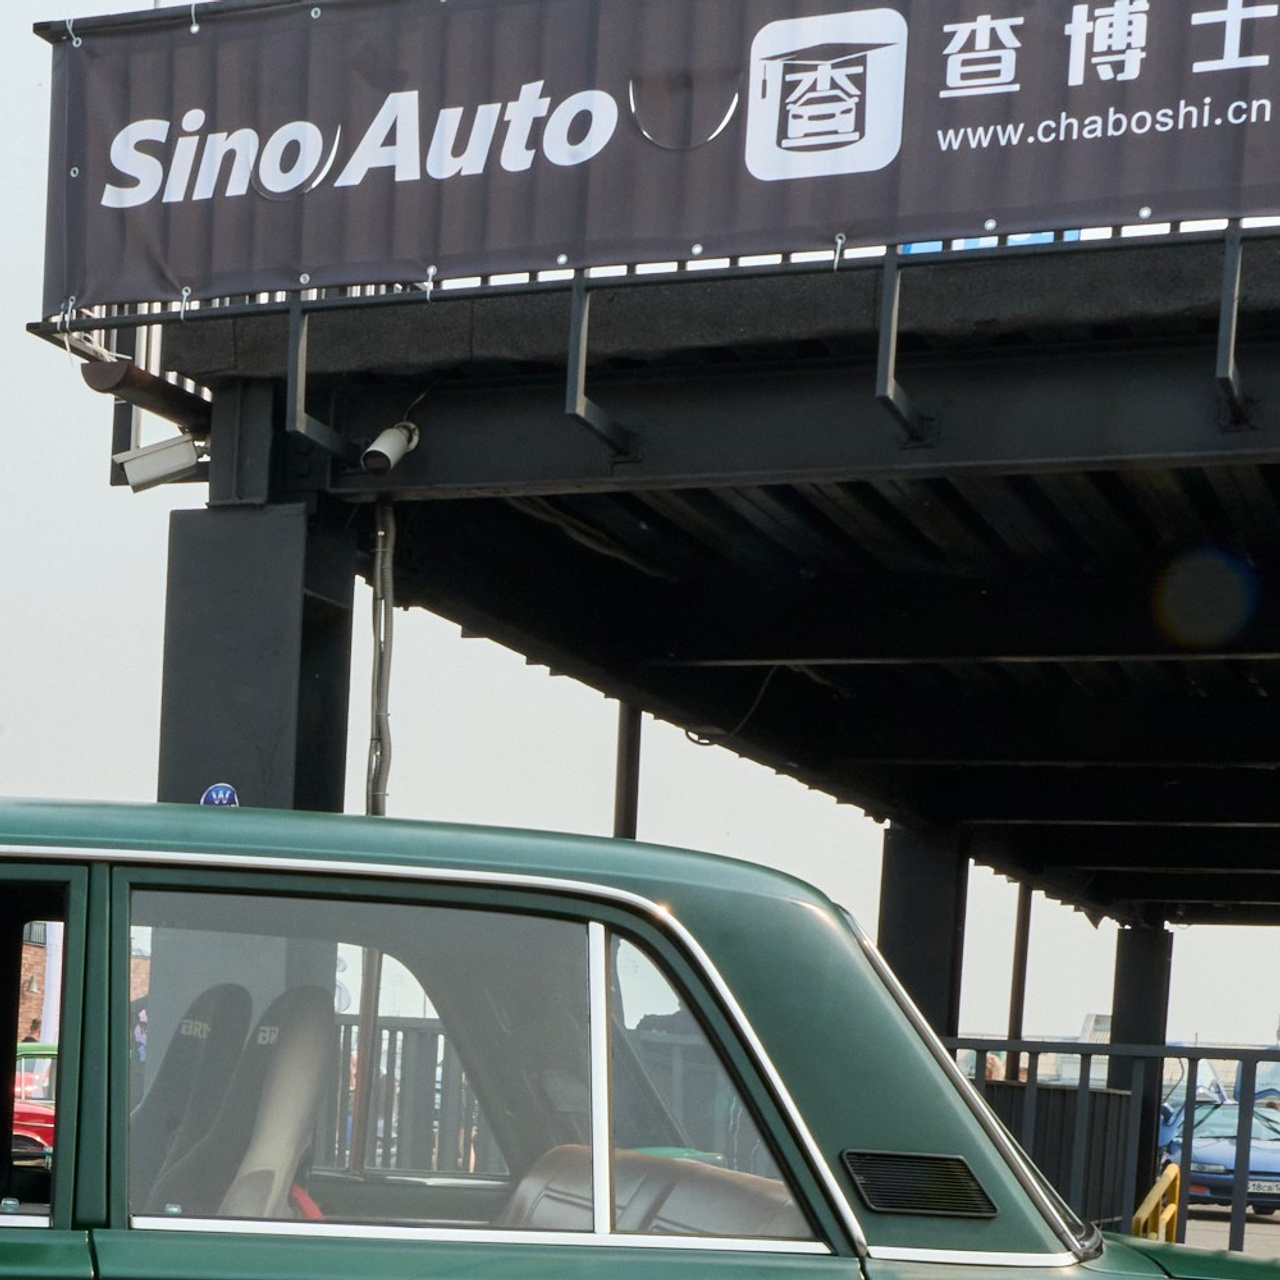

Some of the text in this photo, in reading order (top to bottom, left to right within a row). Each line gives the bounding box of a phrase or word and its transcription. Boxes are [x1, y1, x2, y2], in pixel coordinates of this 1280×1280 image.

[939, 0, 1278, 98] 查博士
[101, 80, 618, 208] Sino Auto
[936, 97, 1272, 151] www.chaboshi.cn
